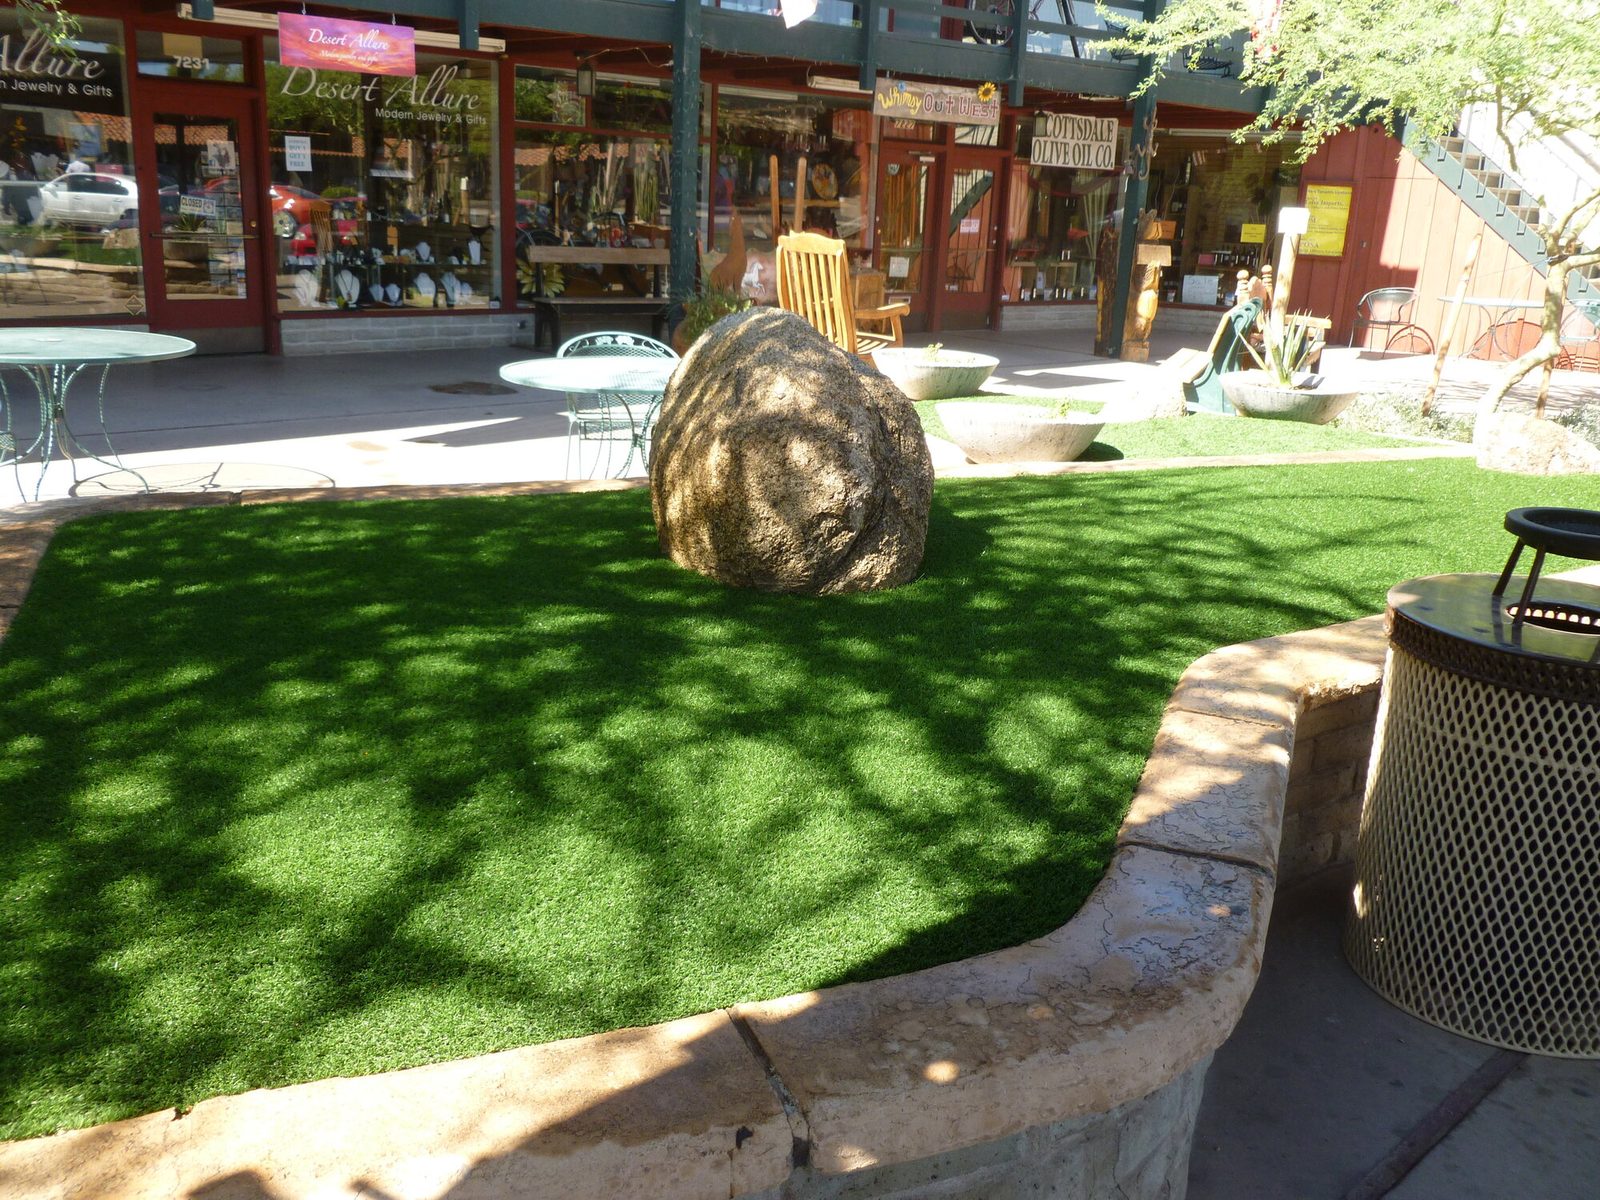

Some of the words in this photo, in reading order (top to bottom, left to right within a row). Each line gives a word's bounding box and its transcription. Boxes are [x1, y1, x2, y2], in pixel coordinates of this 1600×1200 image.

[308, 28, 347, 46] Desert
[349, 29, 390, 50] Allure
[173, 55, 210, 70] 7231
[11, 79, 62, 95] Jewelry
[67, 82, 78, 94] &
[82, 84, 113, 97] Gifts
[280, 66, 380, 102] Desert
[383, 64, 481, 110] Allure
[877, 86, 922, 115] Whimsy
[375, 108, 414, 120] Modern
[416, 111, 452, 123] Jewelry
[455, 114, 462, 123] &
[466, 114, 487, 125] Gifts
[1045, 114, 1114, 142] COTTSDALE
[1032, 139, 1070, 165] OLIVE
[1072, 142, 1093, 167] OIL
[1095, 144, 1114, 168] CO.
[181, 197, 203, 208] CLOSED
